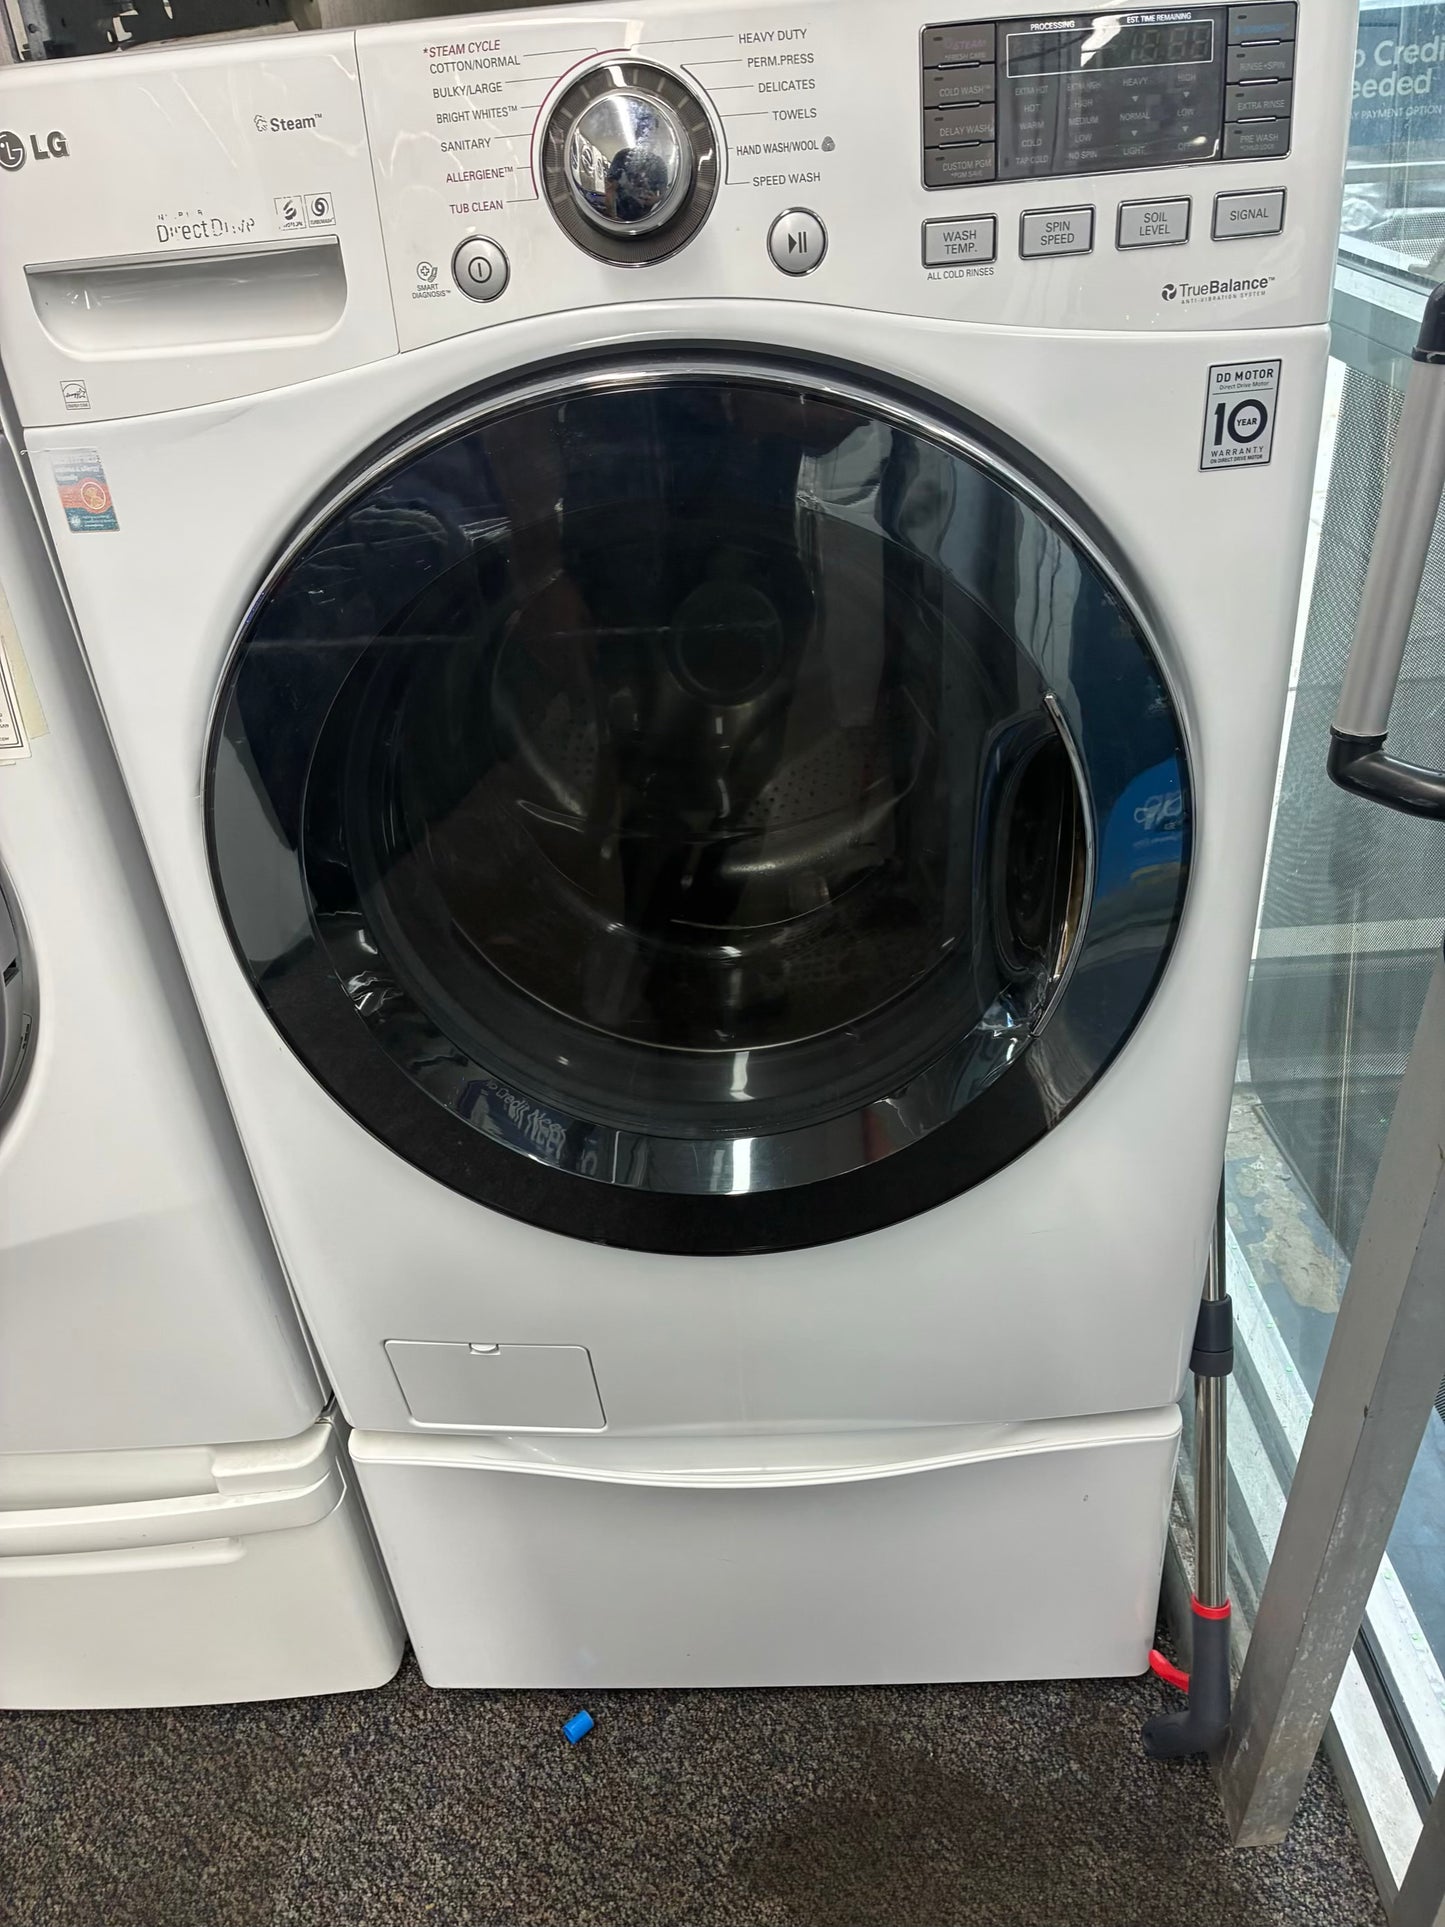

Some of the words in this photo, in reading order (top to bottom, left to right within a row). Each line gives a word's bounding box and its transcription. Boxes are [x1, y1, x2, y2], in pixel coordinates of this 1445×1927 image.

[1126, 15, 1140, 24] EST.
[1140, 14, 1155, 23] TIME
[1156, 12, 1192, 21] REMAINING
[1030, 20, 1076, 31] PROCESSING
[738, 31, 775, 44] HEAVY
[777, 28, 807, 41] DUTY
[468, 39, 501, 54] CYCLE
[430, 55, 520, 75] COTTON/NORMAL
[747, 53, 815, 68] PERM.PRESS
[758, 78, 816, 93] DELICATES
[1122, 76, 1148, 87] HEAVY
[432, 82, 503, 98] BULKY/LARGE
[939, 87, 960, 97] COLD
[1024, 103, 1040, 112] HOT
[1237, 101, 1262, 111] EXTRA
[1263, 99, 1285, 109] RINSE
[436, 111, 470, 124] BRIGHT
[772, 107, 817, 121] TOWELS
[1119, 111, 1150, 121] NORMAL
[1176, 107, 1195, 118] LOW
[1361, 107, 1402, 120] PAYMENT
[1019, 120, 1044, 130] WARM
[1068, 116, 1099, 126] MEDIUM
[940, 125, 964, 137] DELAY
[965, 123, 990, 134] WASH
[1021, 138, 1042, 147] COLD
[1074, 133, 1093, 143] LOW
[1240, 134, 1255, 144] PRE
[1255, 132, 1279, 142] WASH
[30, 131, 70, 160] LG
[440, 137, 491, 153] SANITARY
[736, 144, 762, 156] HAND
[763, 139, 820, 153] WASH/WOOL
[1123, 145, 1146, 156] LIGHT
[942, 160, 974, 172] CUSTOM
[975, 159, 992, 168] PGM
[752, 174, 786, 187] SPEED
[788, 171, 821, 184] WASH
[449, 203, 469, 214] TUB
[471, 200, 504, 213] CLEAN
[1144, 211, 1168, 224] SOIL
[1229, 208, 1269, 221] SIGNAL
[1045, 221, 1071, 233] SPIN
[1139, 224, 1171, 237] LEVEL
[943, 230, 977, 242] WASH
[1040, 233, 1075, 246] SPEED
[945, 243, 978, 255] TEMP.
[927, 271, 942, 281] ALL
[943, 269, 965, 279] COLD
[966, 267, 995, 278] RINSES
[416, 283, 438, 292] SMART
[1181, 293, 1237, 304] ANTI-VIBRATION
[1240, 291, 1266, 299] SYSTEM
[1216, 372, 1231, 384] DD
[1234, 368, 1274, 381] MOTOR
[1219, 383, 1237, 391] Direct
[1214, 399, 1268, 447] 10
[1236, 417, 1258, 427] YEAR
[1211, 445, 1264, 458] WARRANTY
